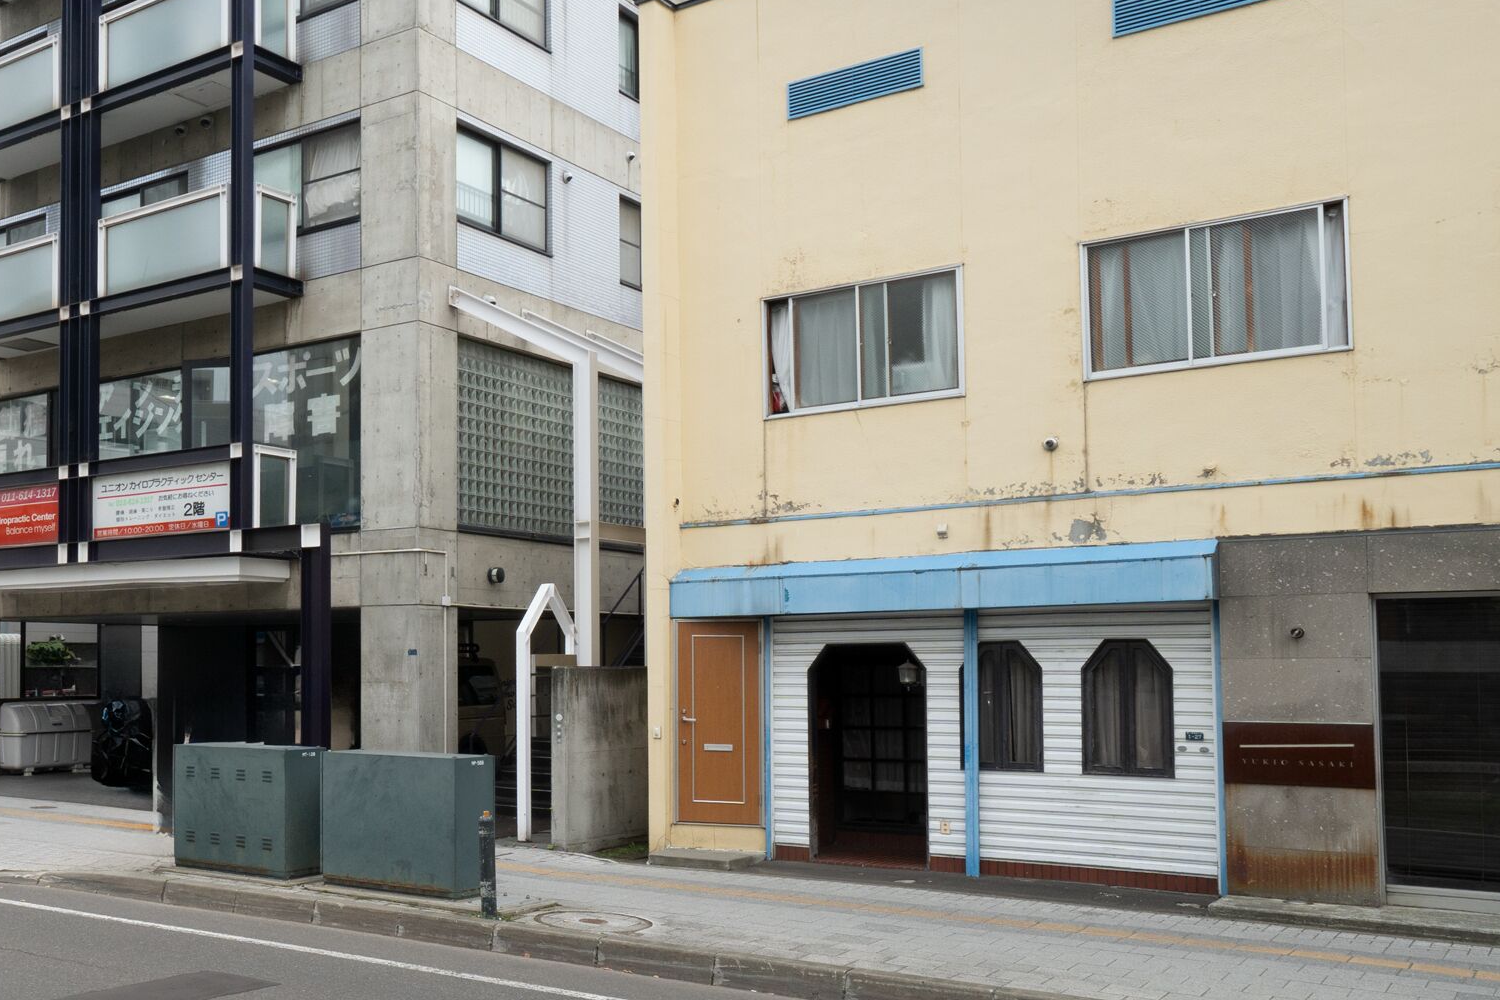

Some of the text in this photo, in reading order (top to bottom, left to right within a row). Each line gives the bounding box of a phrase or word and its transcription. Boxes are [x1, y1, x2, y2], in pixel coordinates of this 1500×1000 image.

[101, 471, 224, 493] ユニオン カイロプラクティック センター
[1, 487, 57, 503] 011-614-1317
[183, 501, 205, 517] 2階
[31, 513, 56, 522] Center
[217, 513, 226, 526] P
[5, 523, 56, 536] Balance myself
[1241, 757, 1355, 769] YUKIO SASAKI
